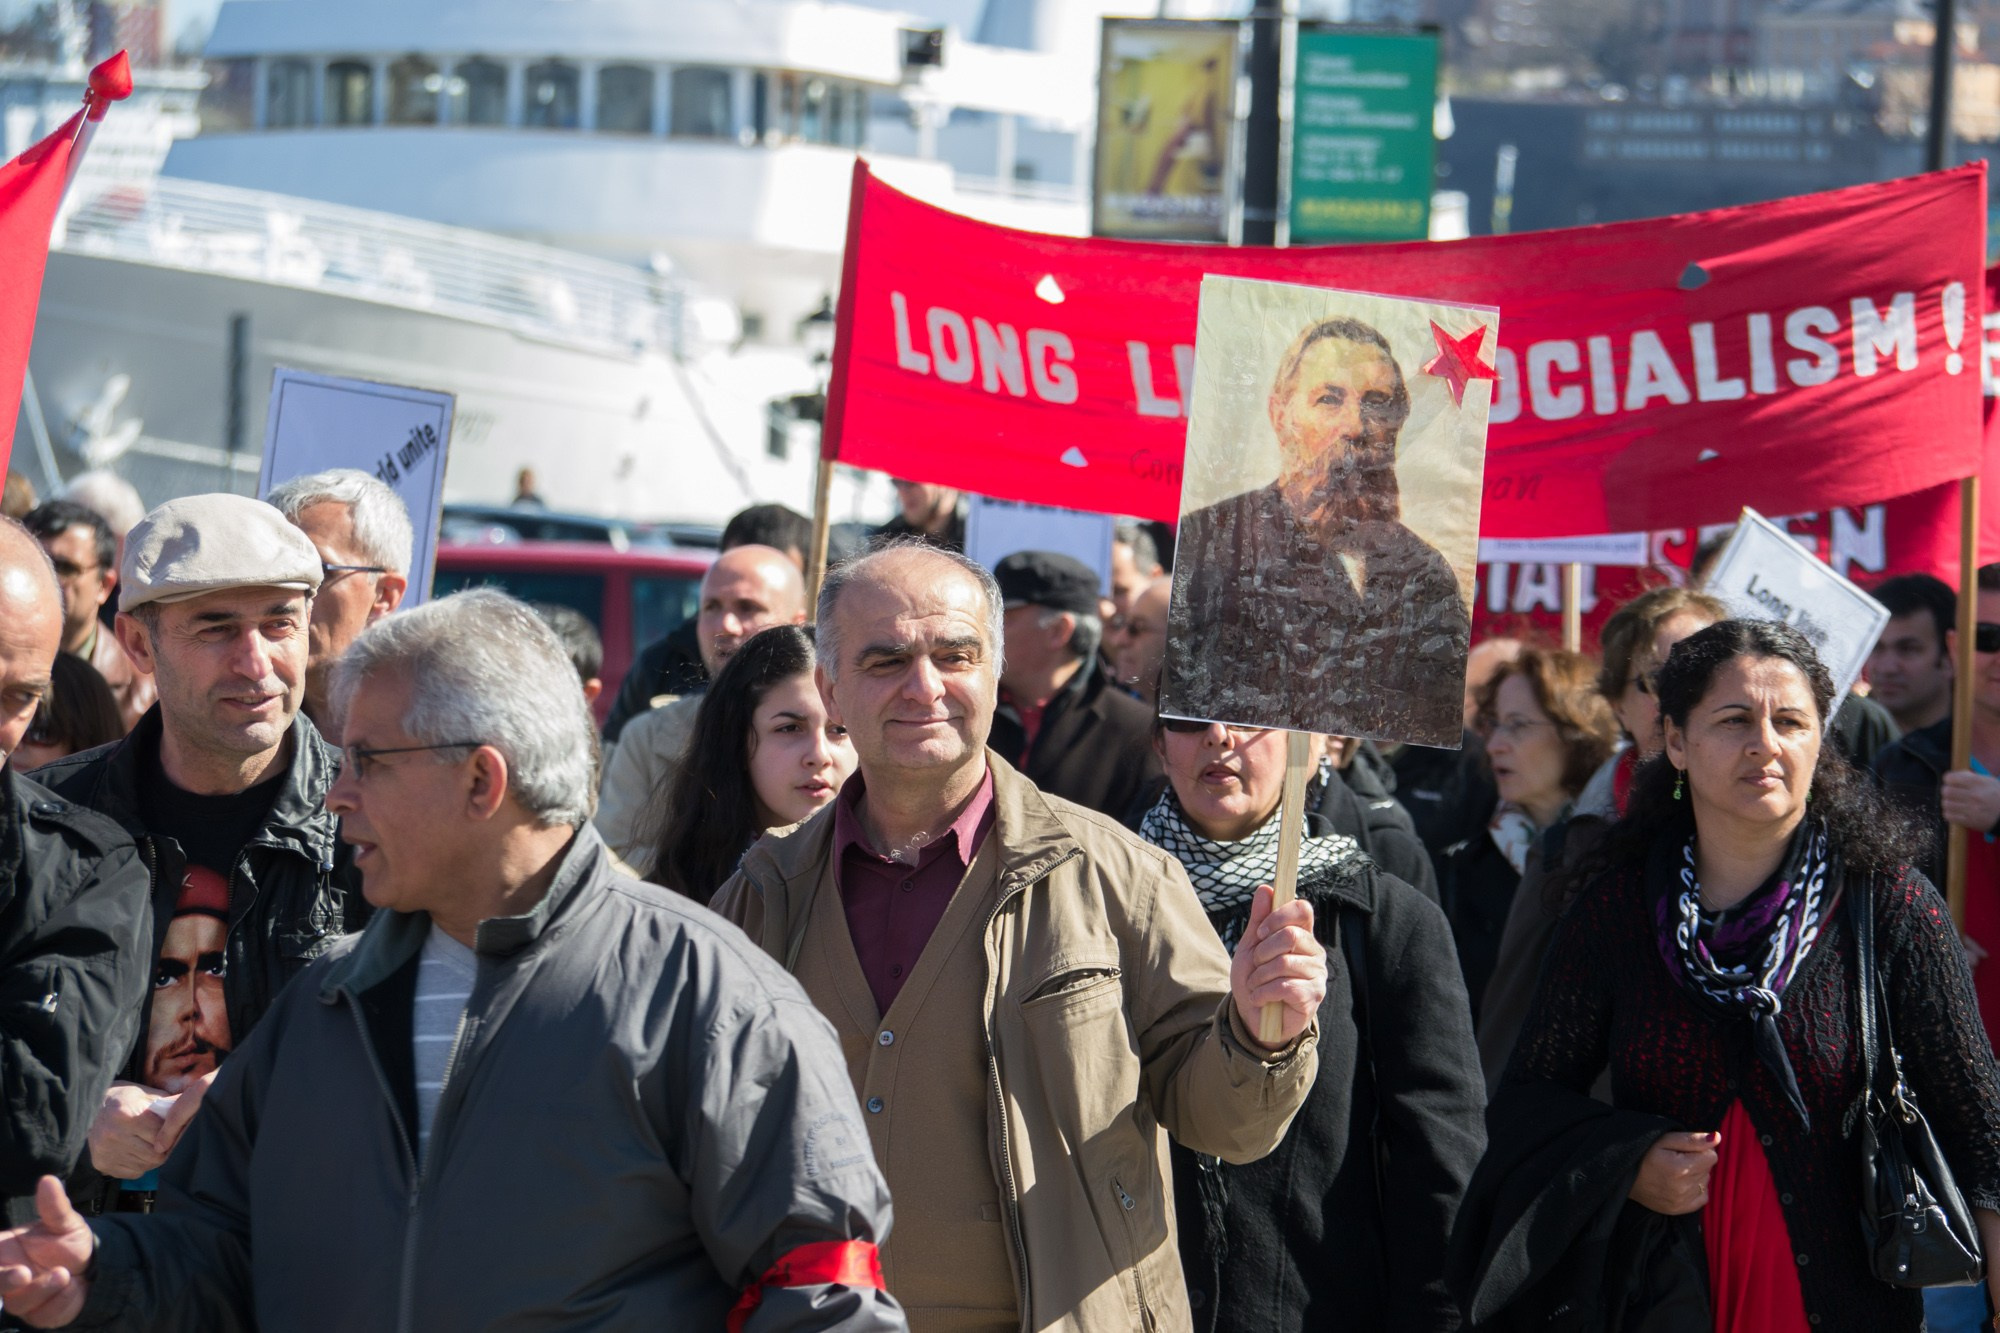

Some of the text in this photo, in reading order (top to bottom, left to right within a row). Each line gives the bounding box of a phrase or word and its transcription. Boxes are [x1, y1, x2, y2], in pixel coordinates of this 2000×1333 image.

[890, 281, 1965, 425] LONG LI OCIALISM!
[376, 452, 400, 486] rld
[397, 423, 437, 471] unite
